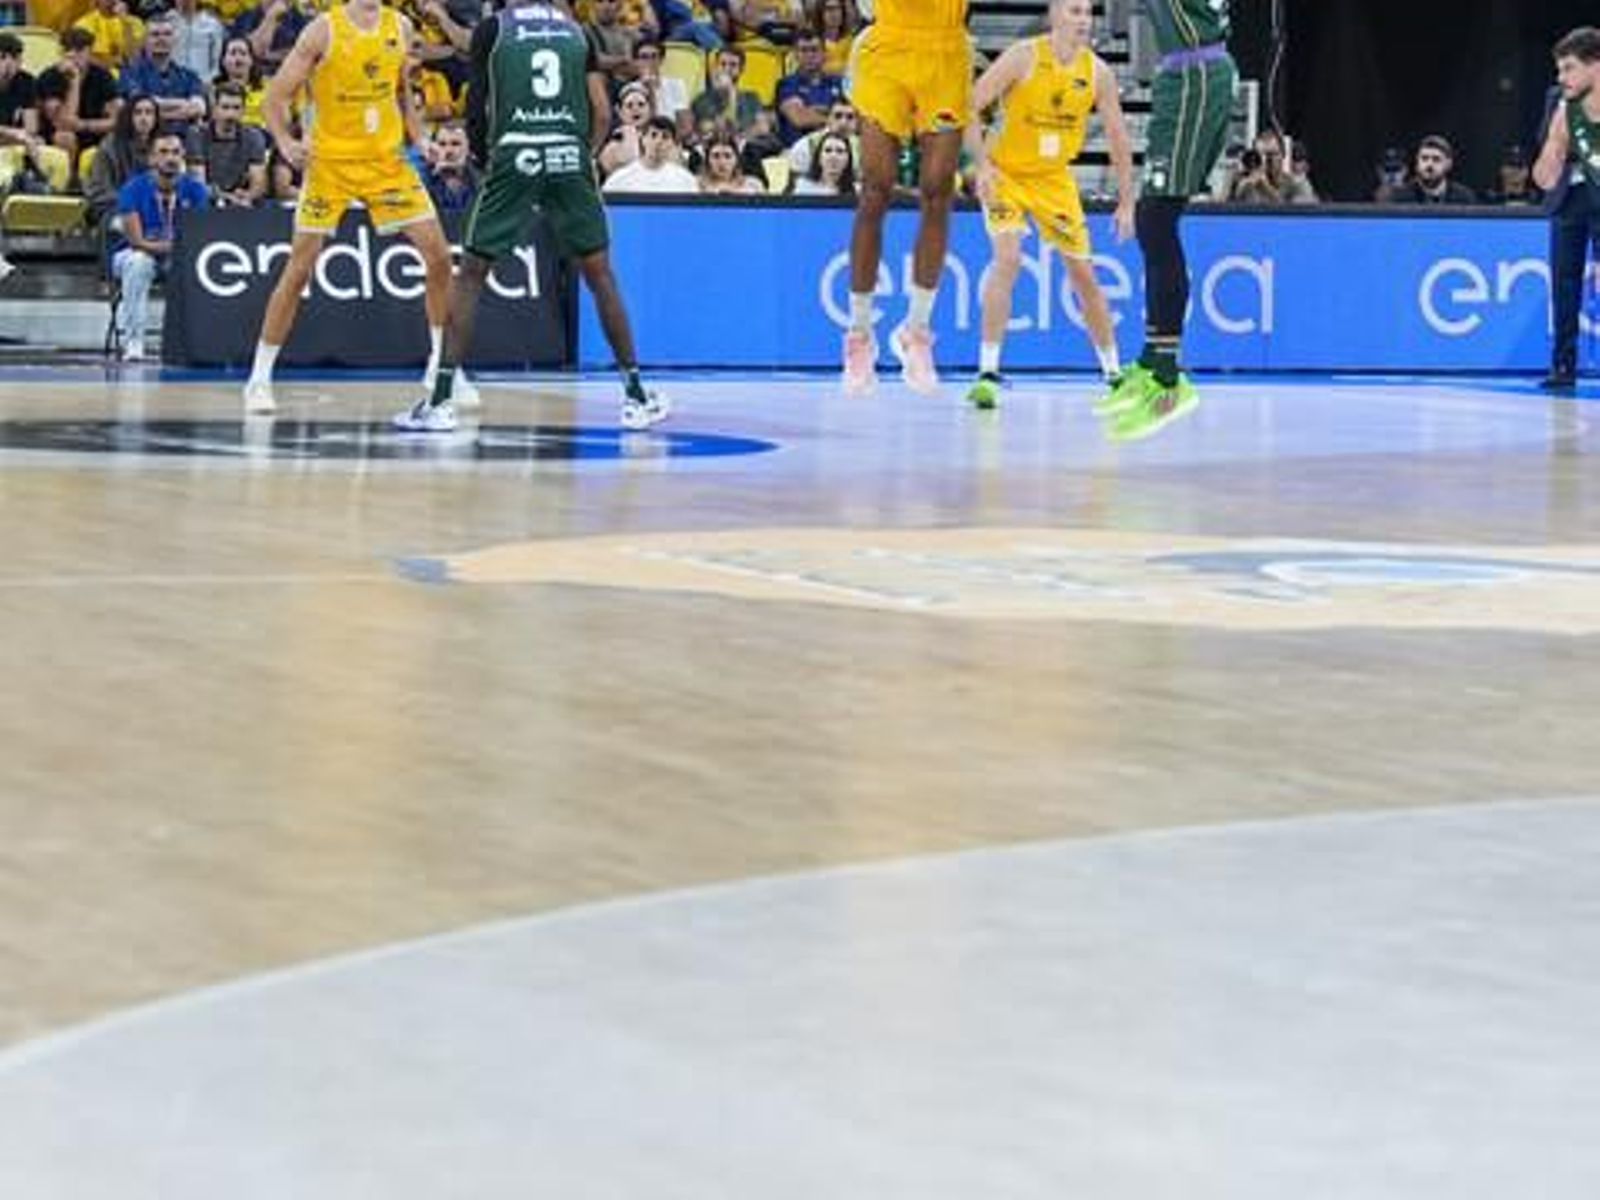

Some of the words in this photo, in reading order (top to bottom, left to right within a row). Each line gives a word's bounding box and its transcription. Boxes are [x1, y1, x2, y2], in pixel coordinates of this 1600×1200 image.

[531, 49, 562, 98] 3
[195, 226, 541, 299] endea
[819, 240, 1275, 333] endea
